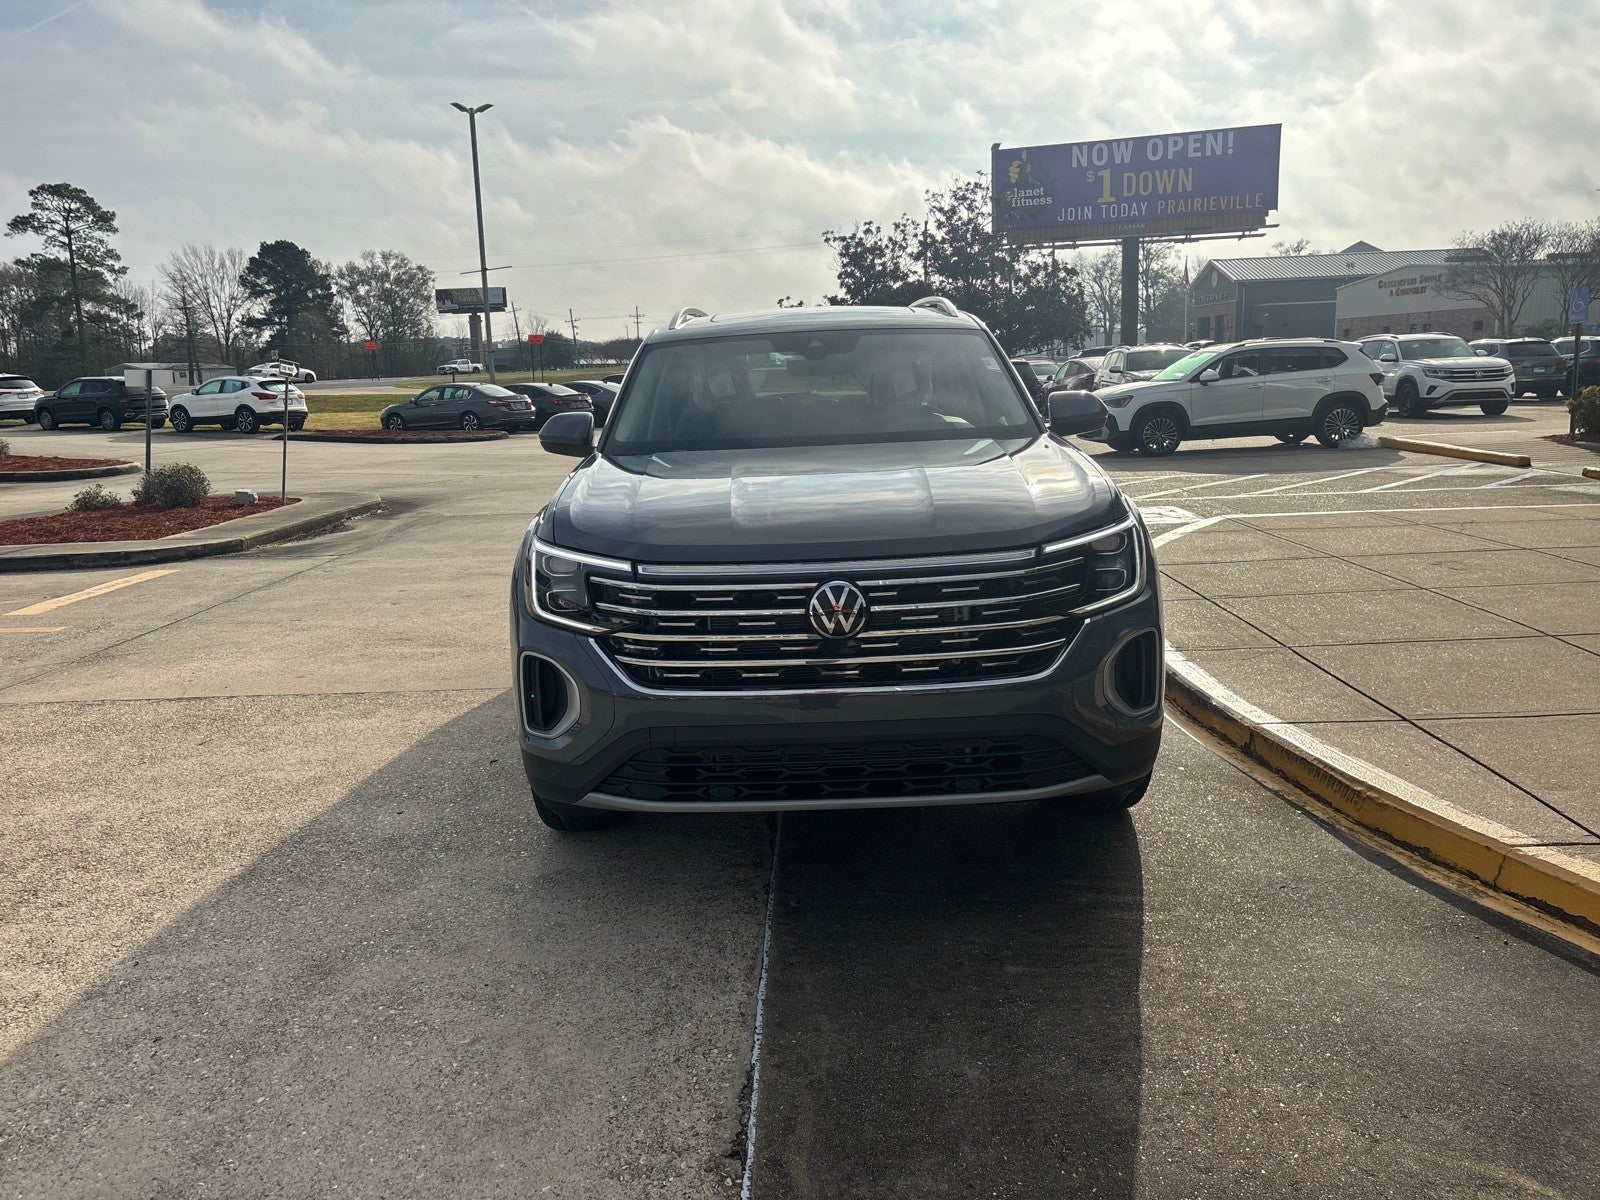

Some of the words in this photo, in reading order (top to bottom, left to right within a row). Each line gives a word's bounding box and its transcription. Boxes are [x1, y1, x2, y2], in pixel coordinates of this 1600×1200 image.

[1071, 140, 1134, 168] NOW
[1146, 131, 1234, 161] OPEN!
[1011, 196, 1053, 207] fitness
[1086, 168, 1116, 203] $1
[1123, 167, 1193, 197] DOWN
[1057, 205, 1092, 222] JOIN
[1100, 201, 1148, 219] TODAY
[1157, 192, 1264, 214] PRAIRIEVILLE
